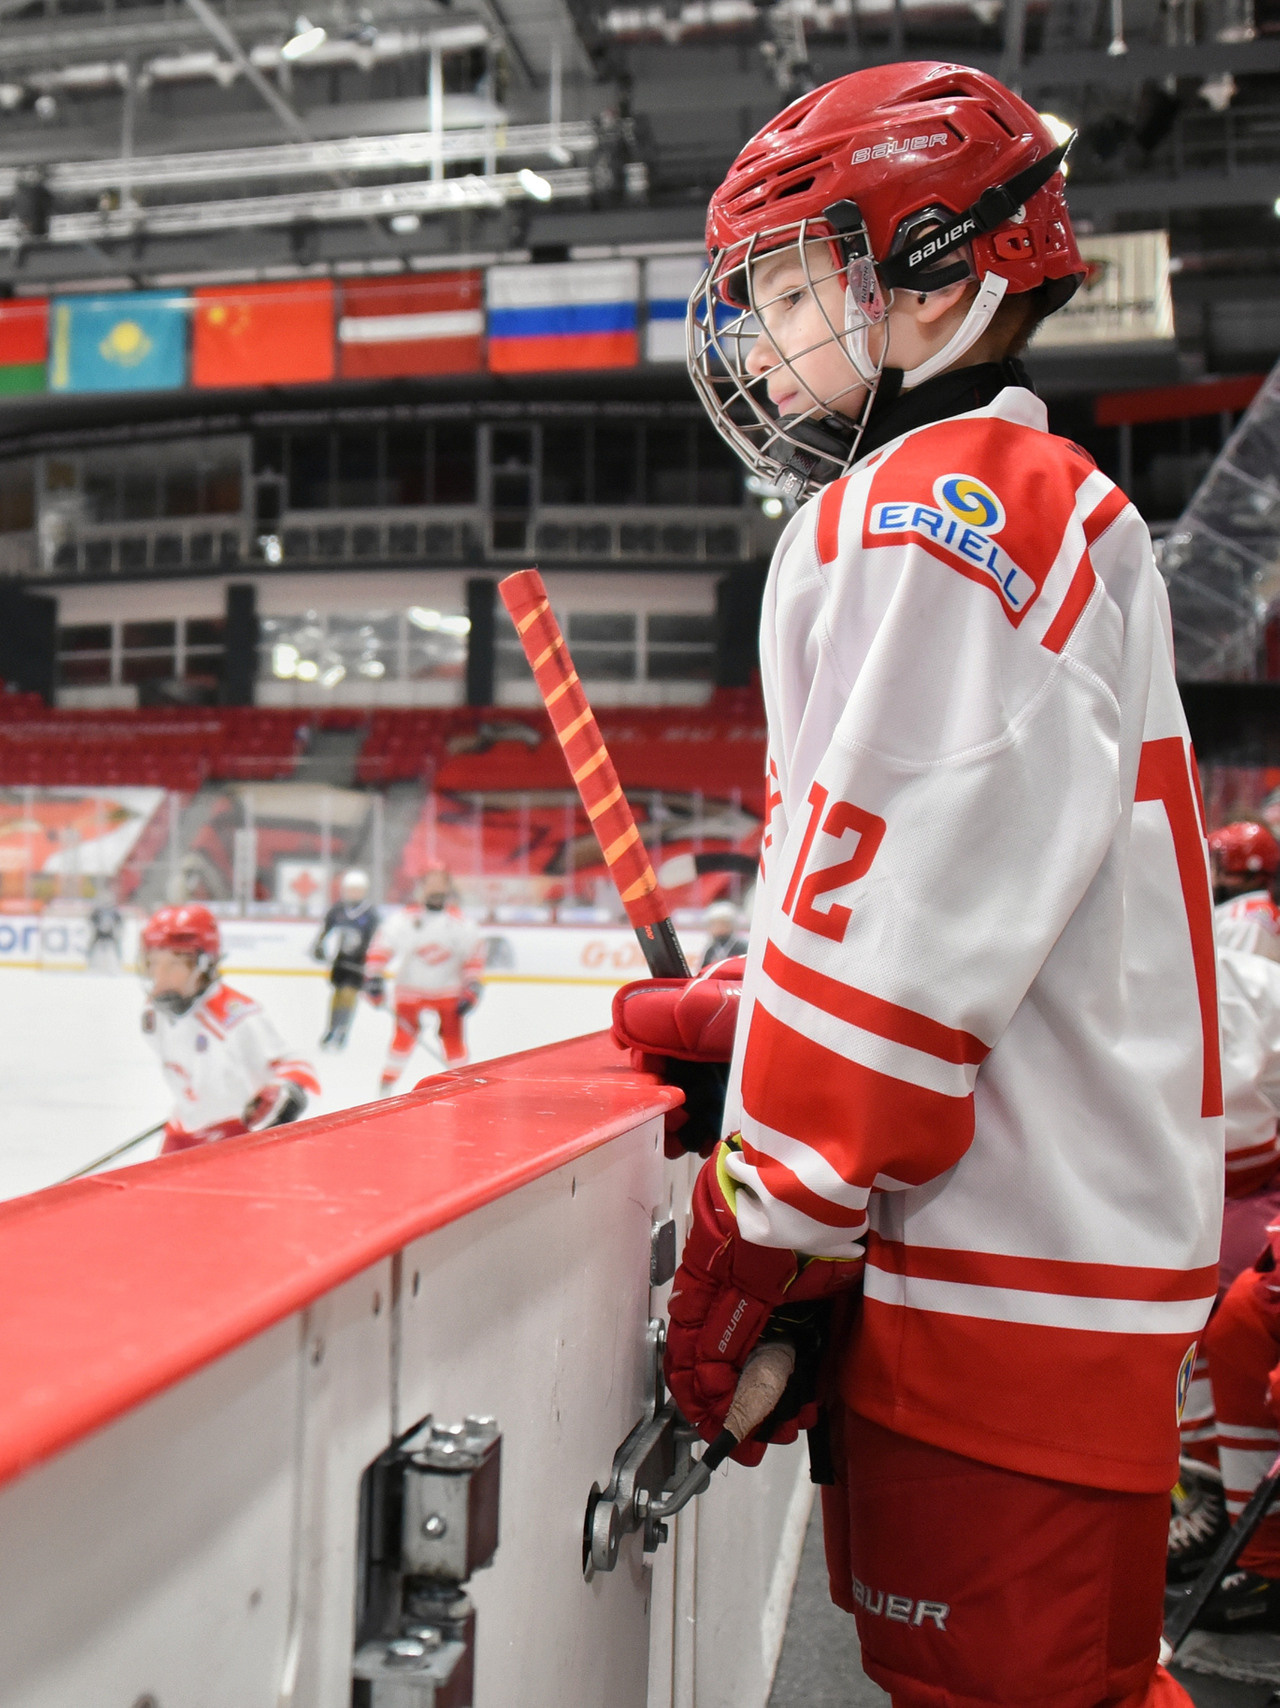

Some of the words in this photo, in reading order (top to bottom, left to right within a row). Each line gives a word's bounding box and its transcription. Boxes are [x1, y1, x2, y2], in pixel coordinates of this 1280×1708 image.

[878, 505, 1020, 606] ERIELL
[781, 780, 887, 943] 12
[851, 1577, 951, 1631] AUER
